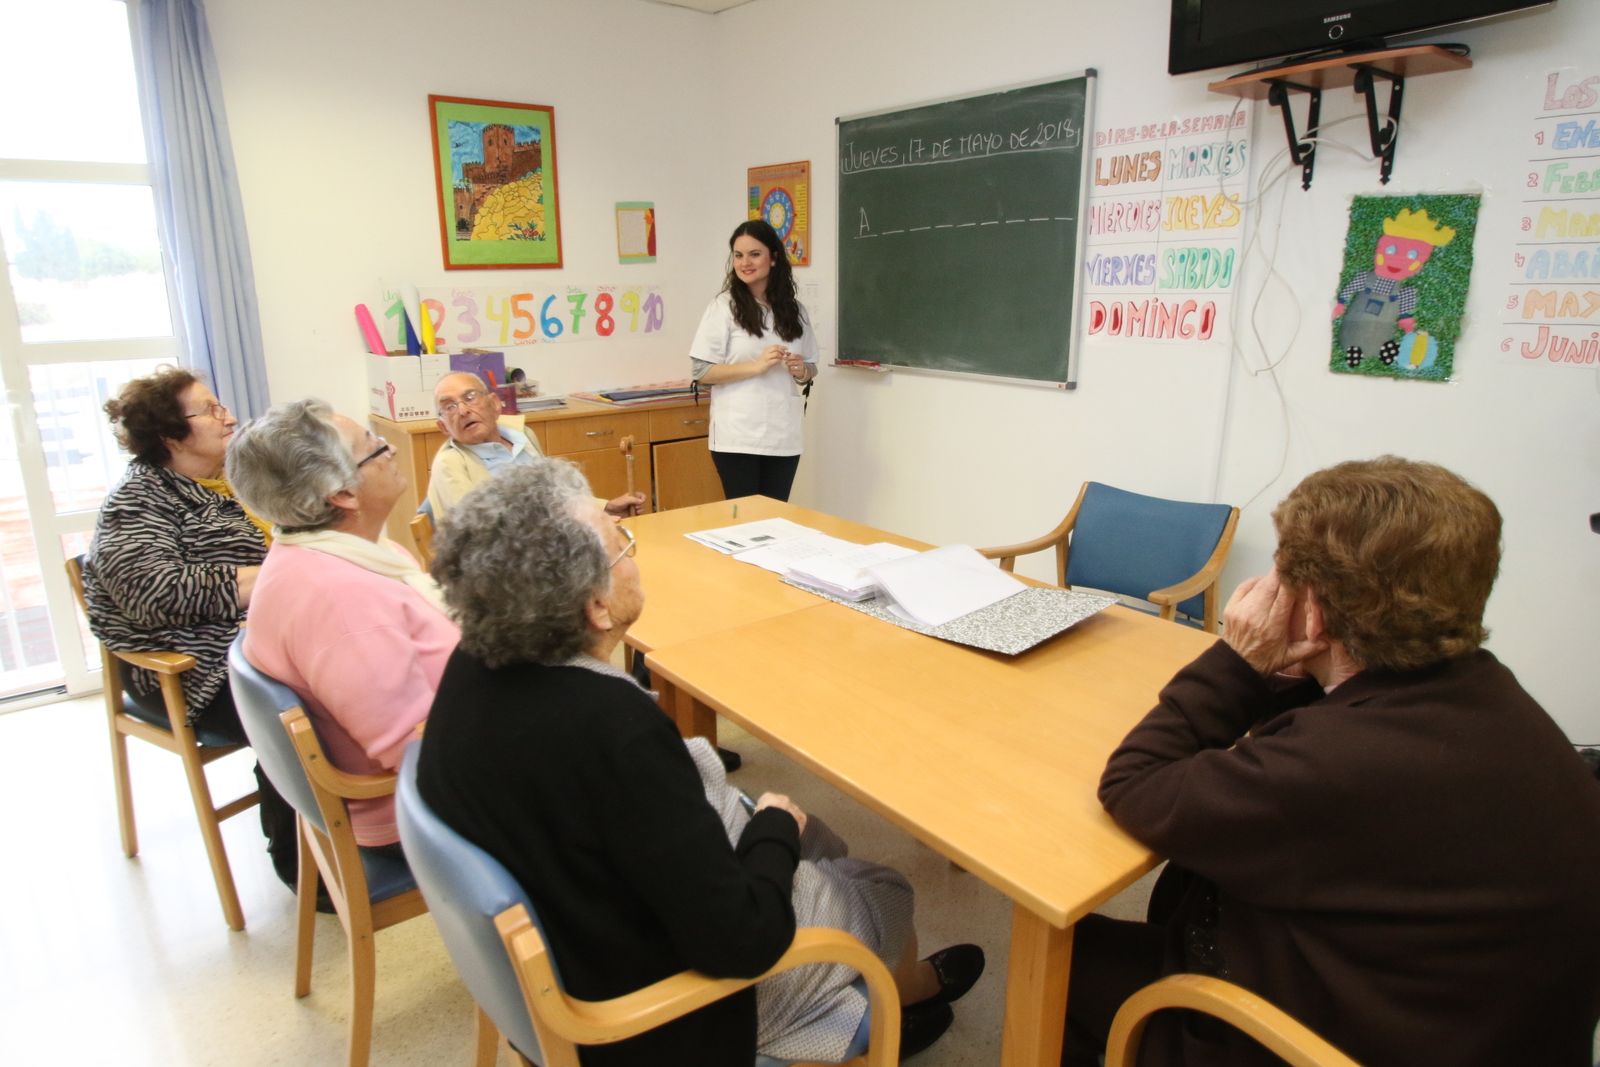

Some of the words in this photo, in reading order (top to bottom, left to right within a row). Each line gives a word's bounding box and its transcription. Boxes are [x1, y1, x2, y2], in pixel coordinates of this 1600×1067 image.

[1323, 12, 1352, 24] SAMSUNG
[908, 138, 926, 162] 17
[931, 138, 951, 159] DE
[959, 132, 1002, 156] MAYO
[1009, 128, 1030, 149] DE
[1534, 131, 1544, 145] 1
[1095, 150, 1162, 186] LUNES
[1167, 139, 1247, 181] MARTES
[1527, 173, 1539, 188] 2
[1162, 193, 1241, 231] JUEVES
[858, 206, 870, 237] A
[1520, 216, 1532, 231] 3
[1086, 252, 1157, 287] VIERNES
[1158, 247, 1235, 289] SABADO
[1514, 252, 1525, 268] 4
[1506, 295, 1518, 310] 5
[384, 298, 407, 345] 1
[452, 294, 481, 343] 3
[485, 294, 510, 345] 4
[510, 292, 536, 339] 5
[540, 293, 564, 339] 6
[567, 292, 588, 335] 7
[594, 292, 616, 337] 8
[619, 291, 641, 333] 9
[643, 292, 665, 334] 10
[1500, 338, 1514, 353] 6
